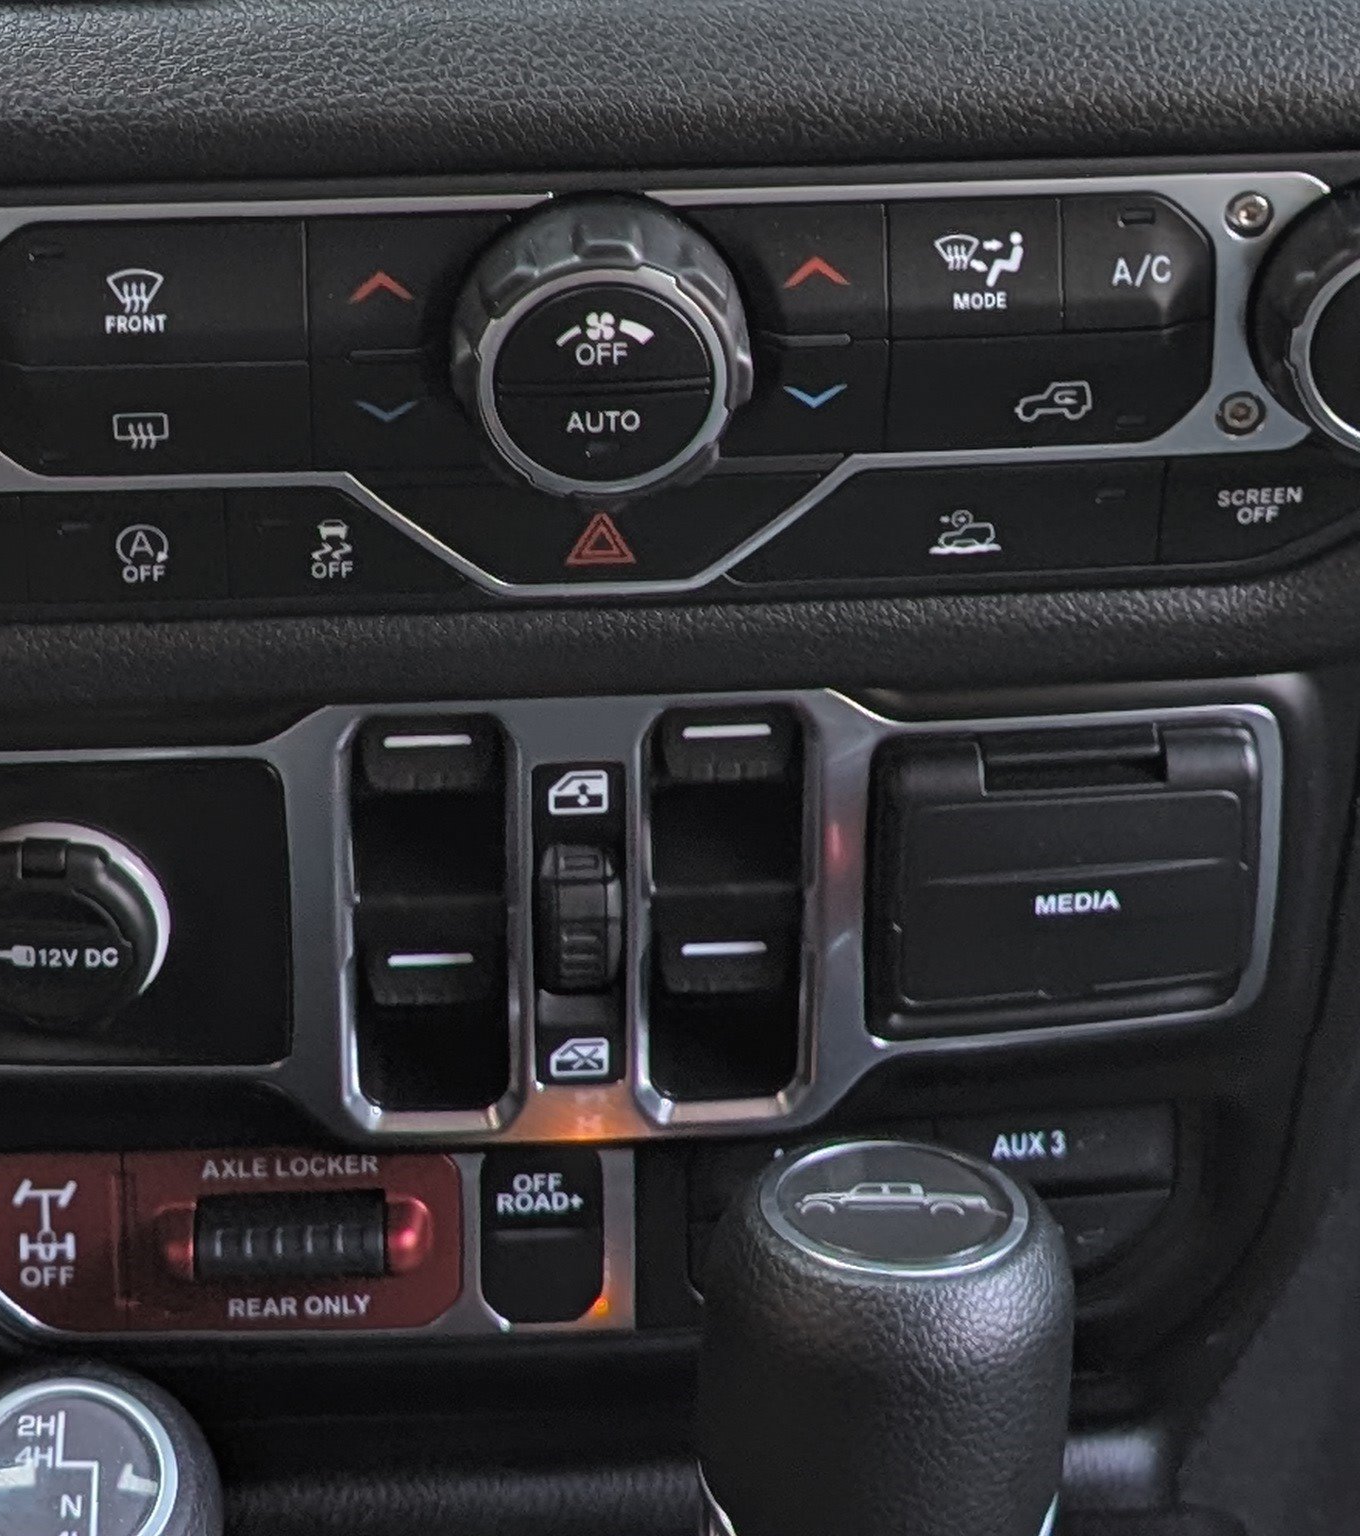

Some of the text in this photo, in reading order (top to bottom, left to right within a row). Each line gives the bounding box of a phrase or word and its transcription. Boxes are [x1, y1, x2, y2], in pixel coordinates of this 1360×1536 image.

[1112, 255, 1172, 287] A/C
[953, 291, 1008, 310] MODE
[105, 313, 168, 335] FRONT
[575, 342, 628, 366] OFF
[566, 410, 641, 434] AUTO
[1217, 485, 1303, 507] SCREEN
[1236, 504, 1280, 524] OFF
[122, 564, 166, 584] OFF
[311, 561, 354, 580] OFF
[1035, 890, 1121, 915] MEDIA
[38, 948, 120, 967] 12V DC
[991, 1129, 1067, 1159] AUX 3
[201, 1154, 380, 1181] AXLE LOCKER
[512, 1173, 563, 1193] OFF
[496, 1191, 585, 1213] ROAD+
[19, 1266, 74, 1289] OFF
[227, 1293, 373, 1318] REAR ONLY
[17, 1414, 56, 1437] 2H
[14, 1445, 54, 1468] 4H
[60, 1494, 83, 1518] N
